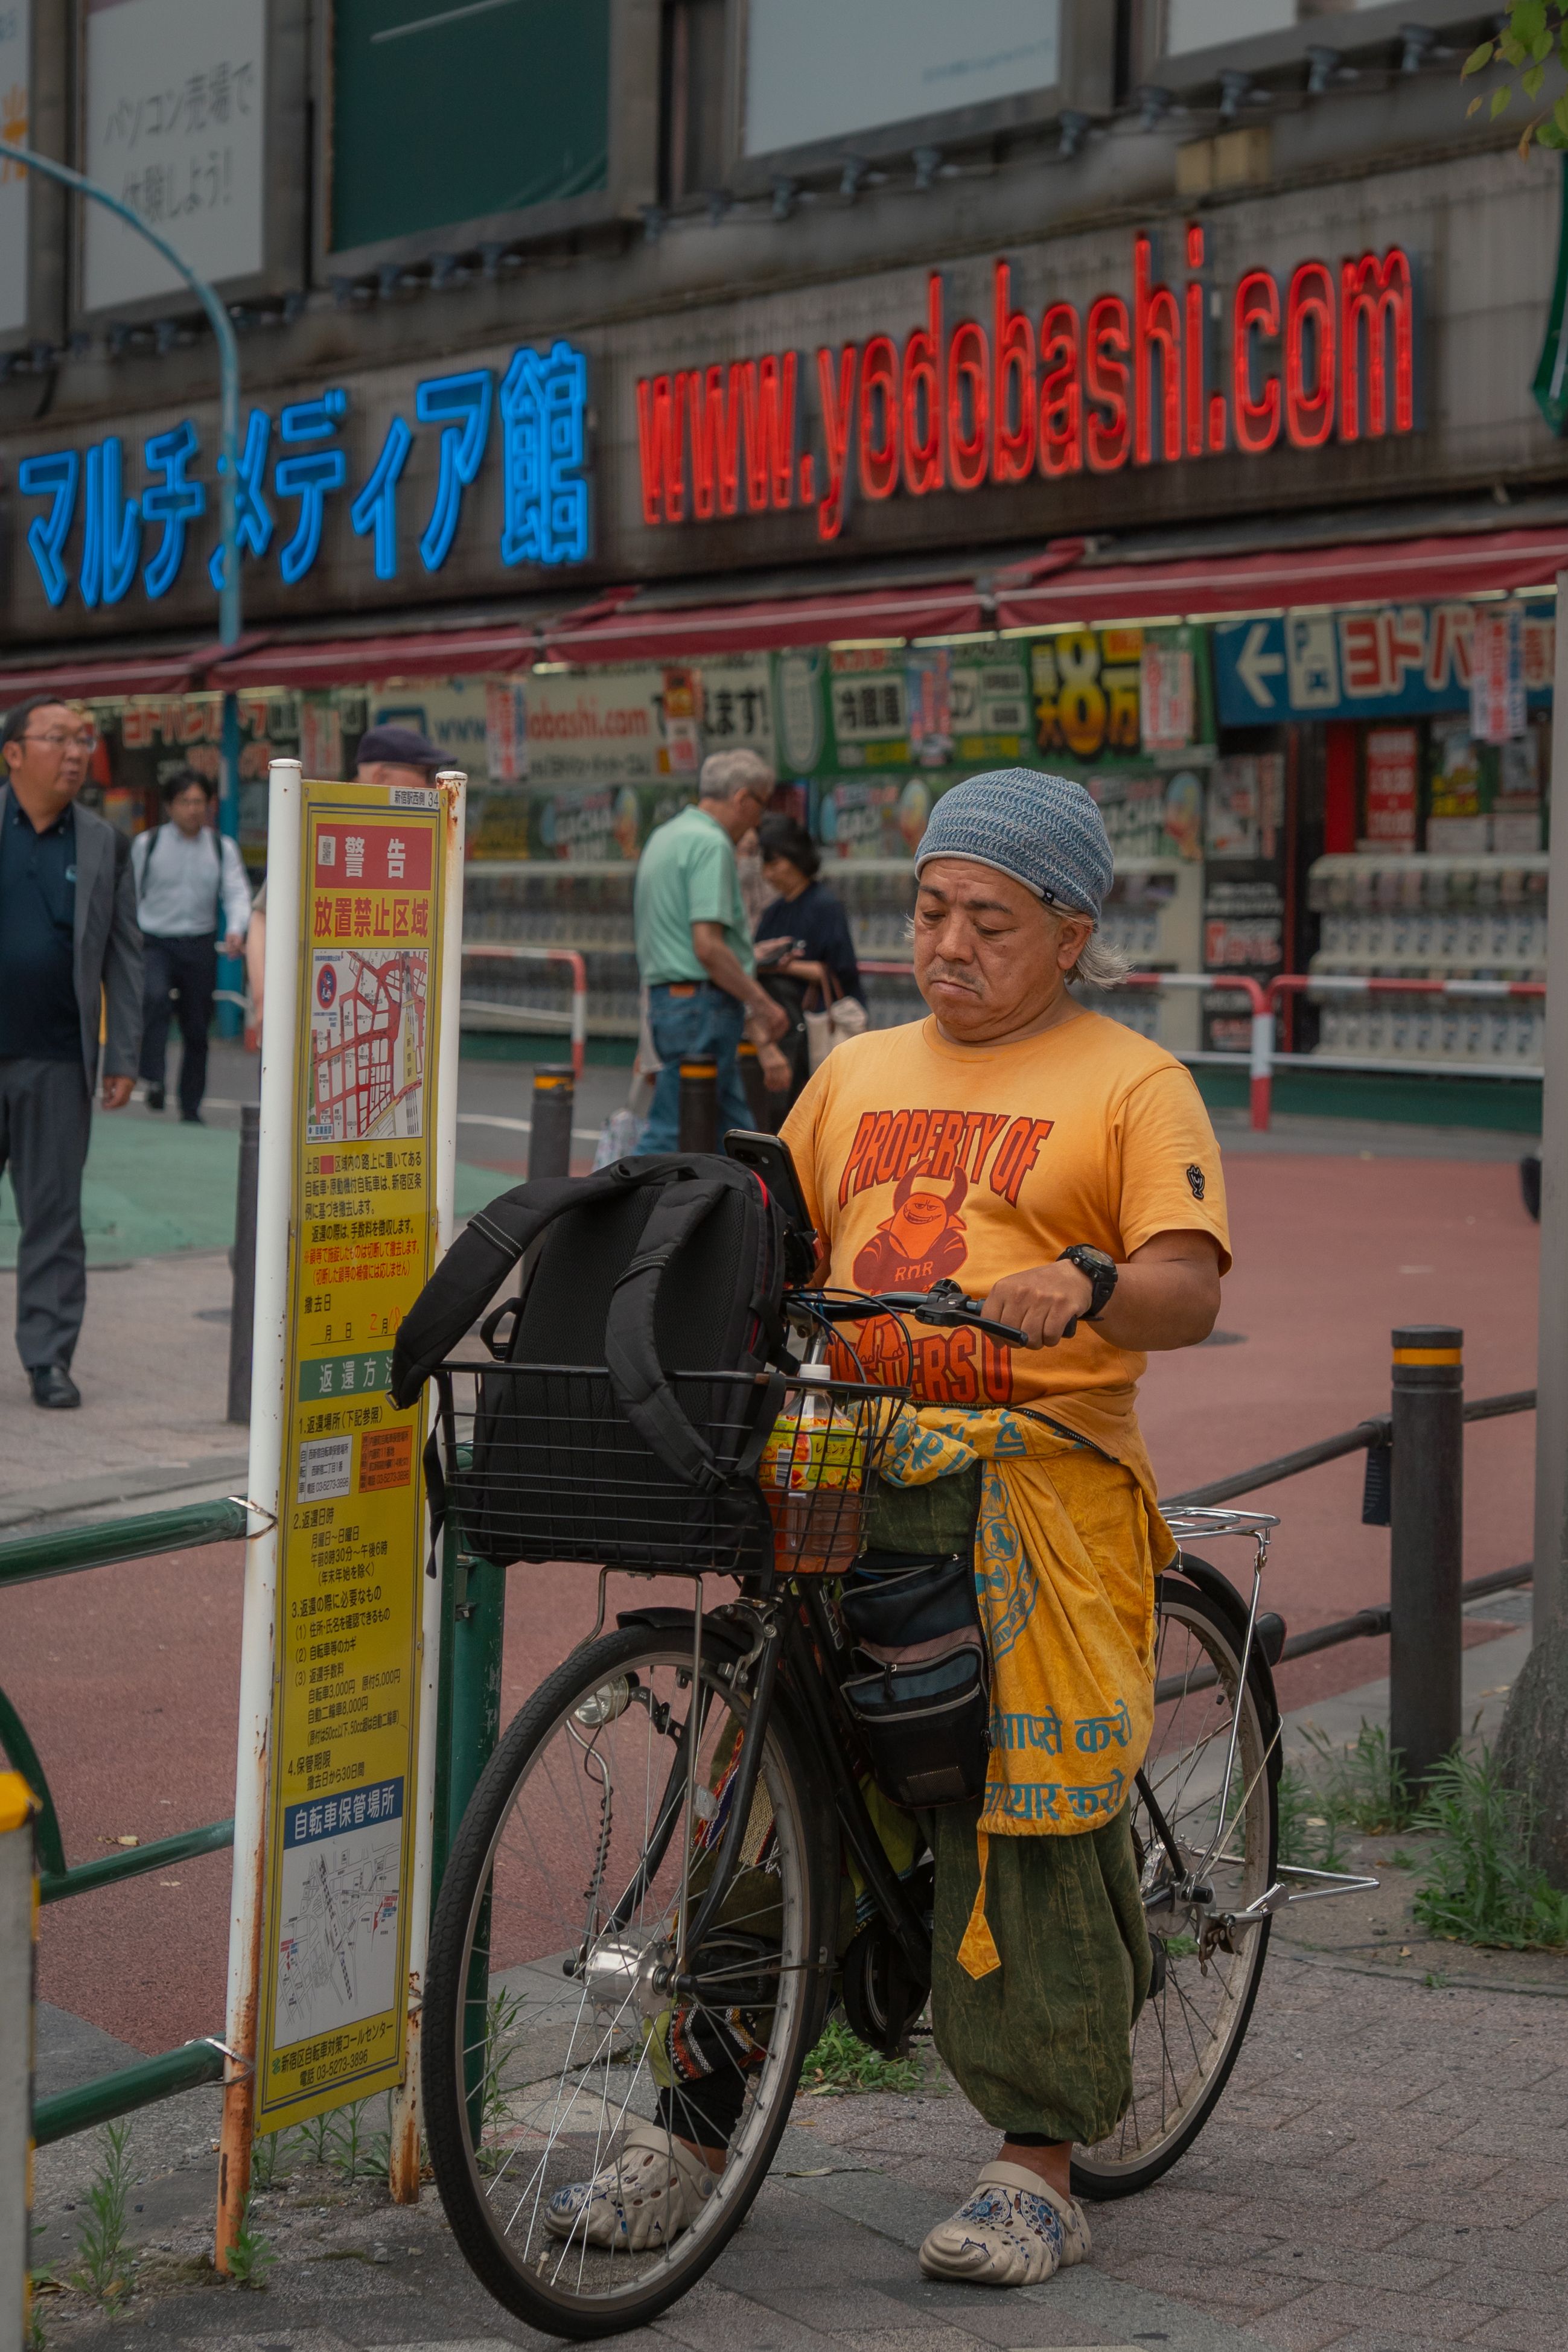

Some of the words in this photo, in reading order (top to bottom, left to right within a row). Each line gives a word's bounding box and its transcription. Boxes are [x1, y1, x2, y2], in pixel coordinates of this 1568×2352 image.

[637, 224, 1414, 541] www.yodobashi.com
[19, 340, 587, 608] マルチメディア館
[395, 790, 425, 806] 新宿駅西側
[428, 791, 439, 808] 34
[344, 836, 406, 879] 警告
[314, 896, 429, 939] 放置禁止区域
[335, 1152, 422, 1173] 区域内の路上に置いてある
[838, 1109, 1012, 1213] PROPERTY
[989, 1117, 1056, 1209] OF
[305, 1199, 374, 1221] 例に基づき撤去します。
[304, 1293, 331, 1314] 撤去日
[325, 1324, 332, 1342] 月
[345, 1322, 352, 1339] 日
[981, 1330, 1014, 1404] U
[815, 1442, 859, 1455] レモンティー
[316, 1477, 349, 1493] 03-5273-3896
[293, 1507, 334, 1530] 2.返還日時
[291, 1586, 382, 1619] 3.返還の際に必要なもの
[310, 1636, 357, 1661] 自転車等のカギ
[308, 1678, 355, 1704] 自転車3,000円
[362, 1668, 401, 1691] 原付5,000円
[309, 1662, 344, 1684] 返還手数料
[288, 1750, 331, 1777] 4.保管期限
[307, 1761, 365, 1792] 撤去日から30日間
[295, 1784, 395, 1841] 自転車保管場所
[281, 2020, 394, 2074] 新宿区自転車対策コールセンター
[299, 2070, 314, 2087] 電話
[316, 2048, 368, 2080] 03-5273-3896
